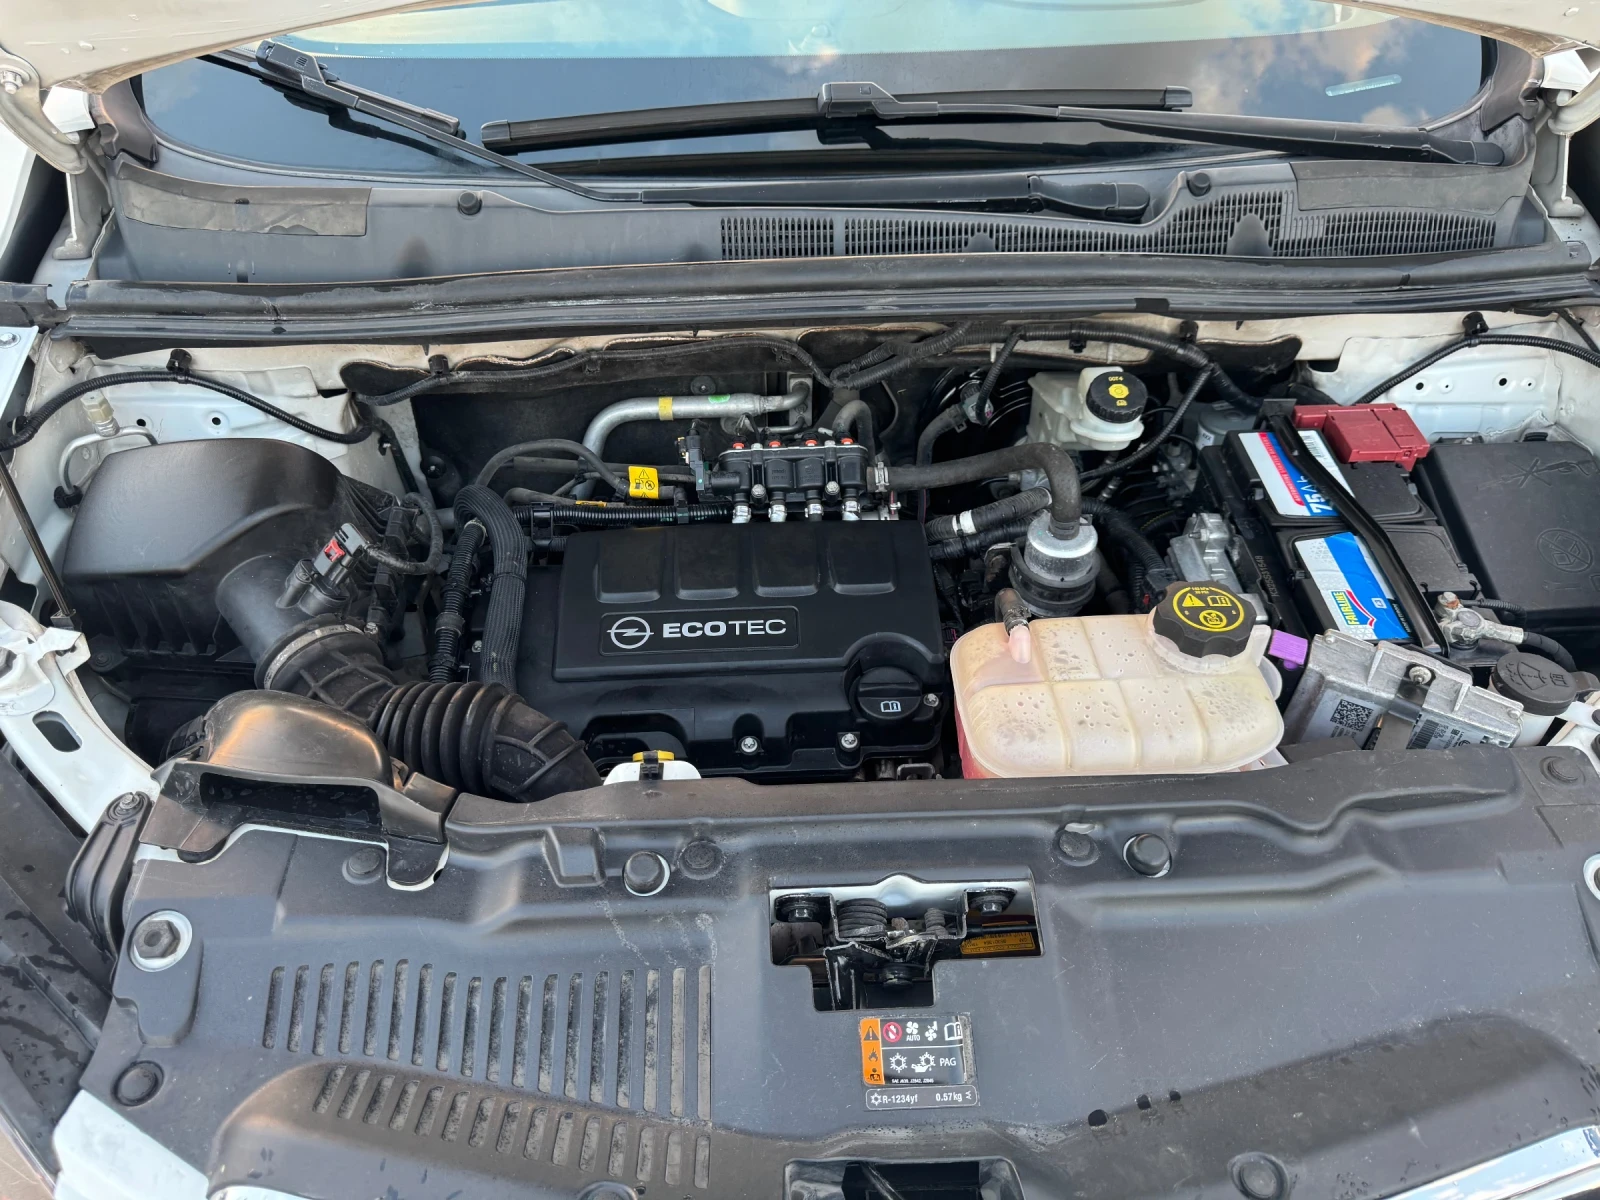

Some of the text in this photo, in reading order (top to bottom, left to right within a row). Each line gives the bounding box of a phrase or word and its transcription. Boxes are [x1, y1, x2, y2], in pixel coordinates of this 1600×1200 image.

[1332, 591, 1360, 625] FAIRLINE
[662, 619, 787, 638] ECOTEC
[906, 1034, 920, 1042] AUTO
[939, 1057, 957, 1067] PAG
[882, 1094, 918, 1105] R-1234yf
